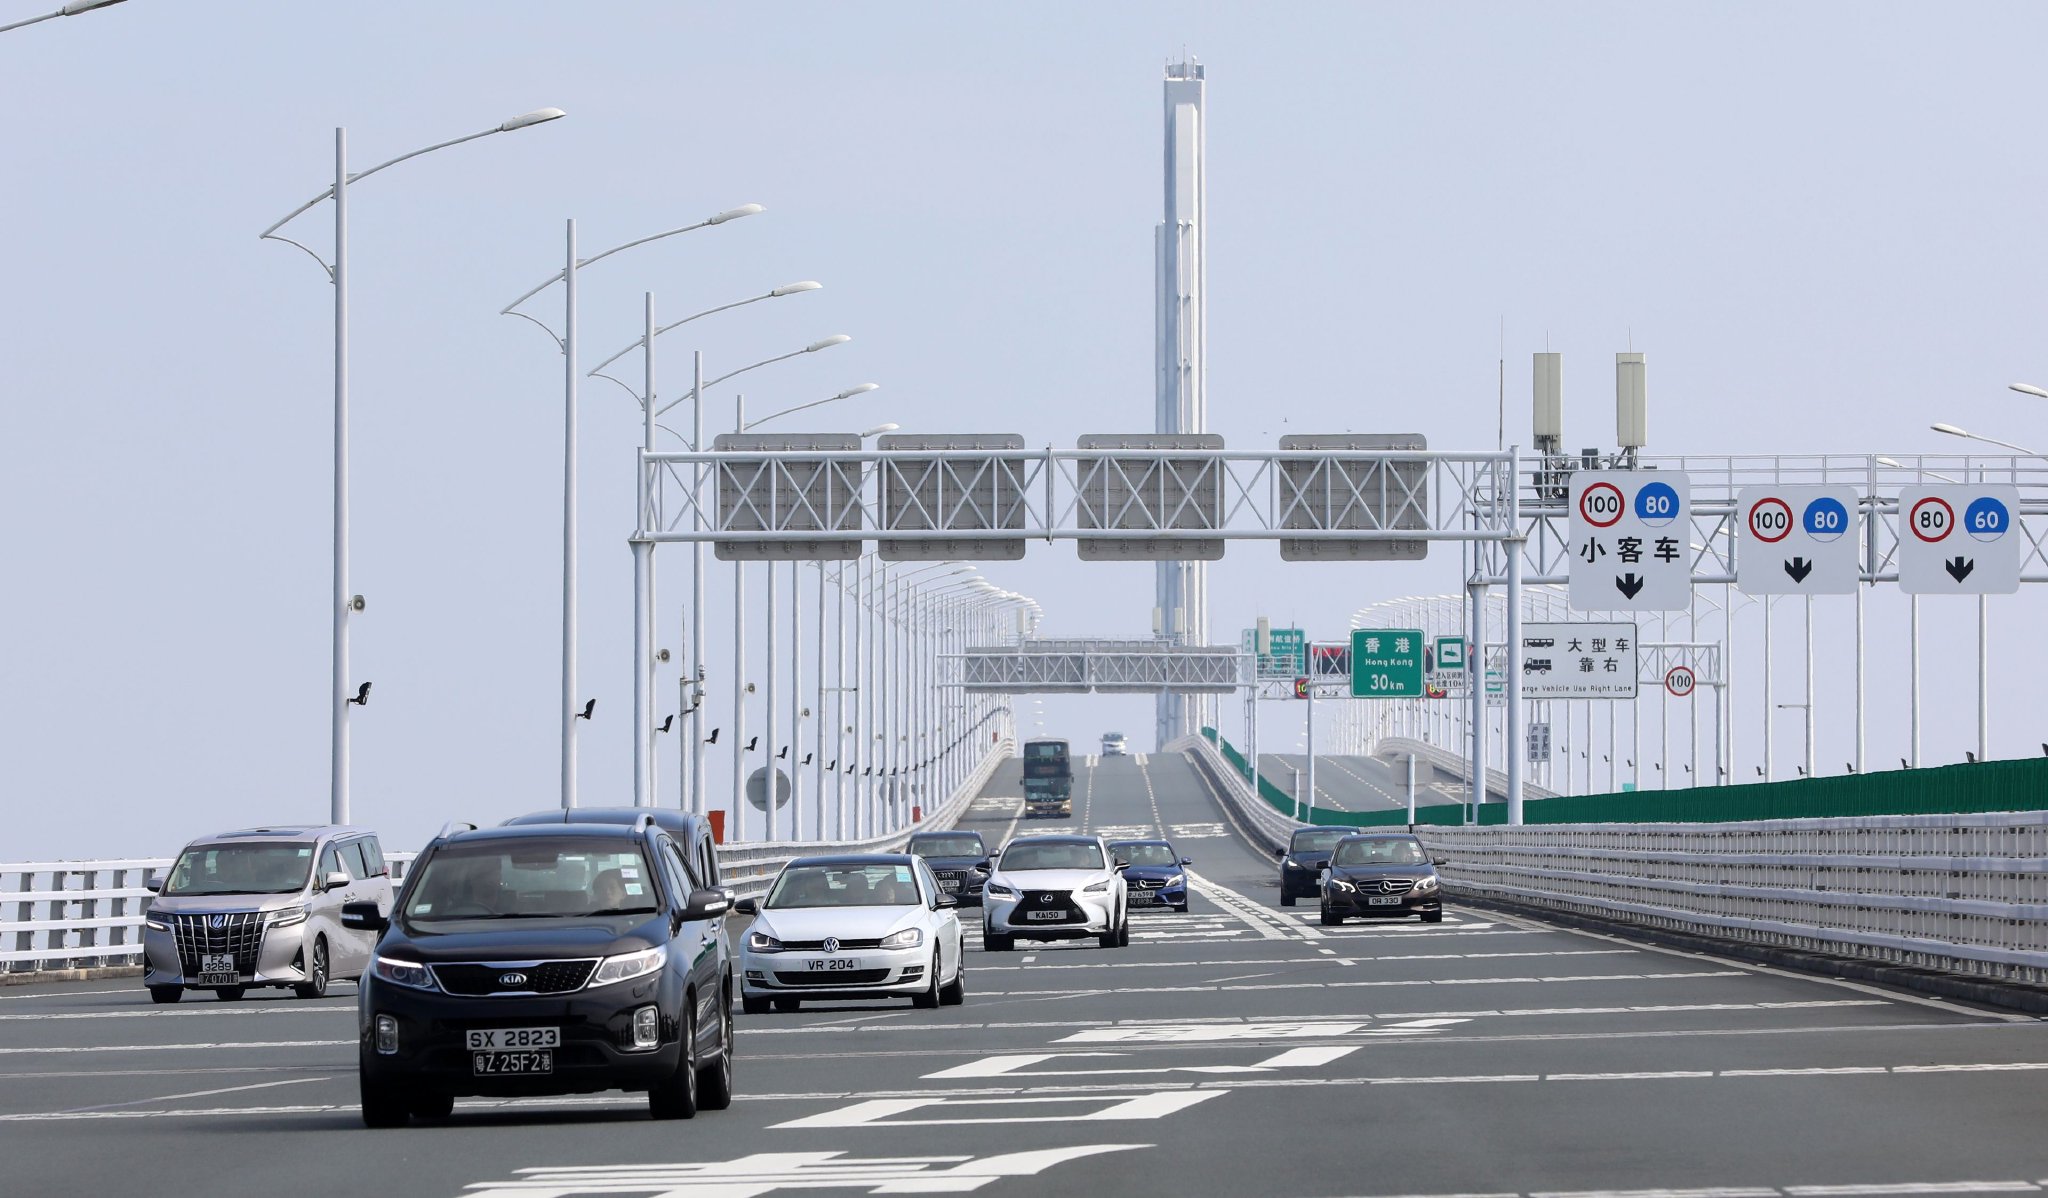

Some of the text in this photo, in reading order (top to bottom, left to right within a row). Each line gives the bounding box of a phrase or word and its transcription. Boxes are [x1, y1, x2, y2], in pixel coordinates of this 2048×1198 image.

[1587, 495, 1618, 513] 100
[1645, 496, 1670, 514] 80
[1755, 512, 1786, 529] 100
[1814, 511, 1838, 529] 80
[1920, 511, 1944, 528] 80
[1975, 511, 1999, 529] 60
[1580, 536, 1680, 564] 小客车
[1365, 637, 1410, 654] 香港
[1567, 638, 1630, 653] 大型车
[1365, 658, 1413, 668] Hong Kong
[1578, 657, 1618, 673] 靠右
[1521, 686, 1538, 694] arge
[1591, 685, 1610, 694] Right
[1670, 675, 1691, 687] 100
[204, 962, 232, 971] 3289
[808, 959, 854, 970] VR 204
[503, 975, 522, 984] KIA
[470, 1030, 557, 1048] SX 2823
